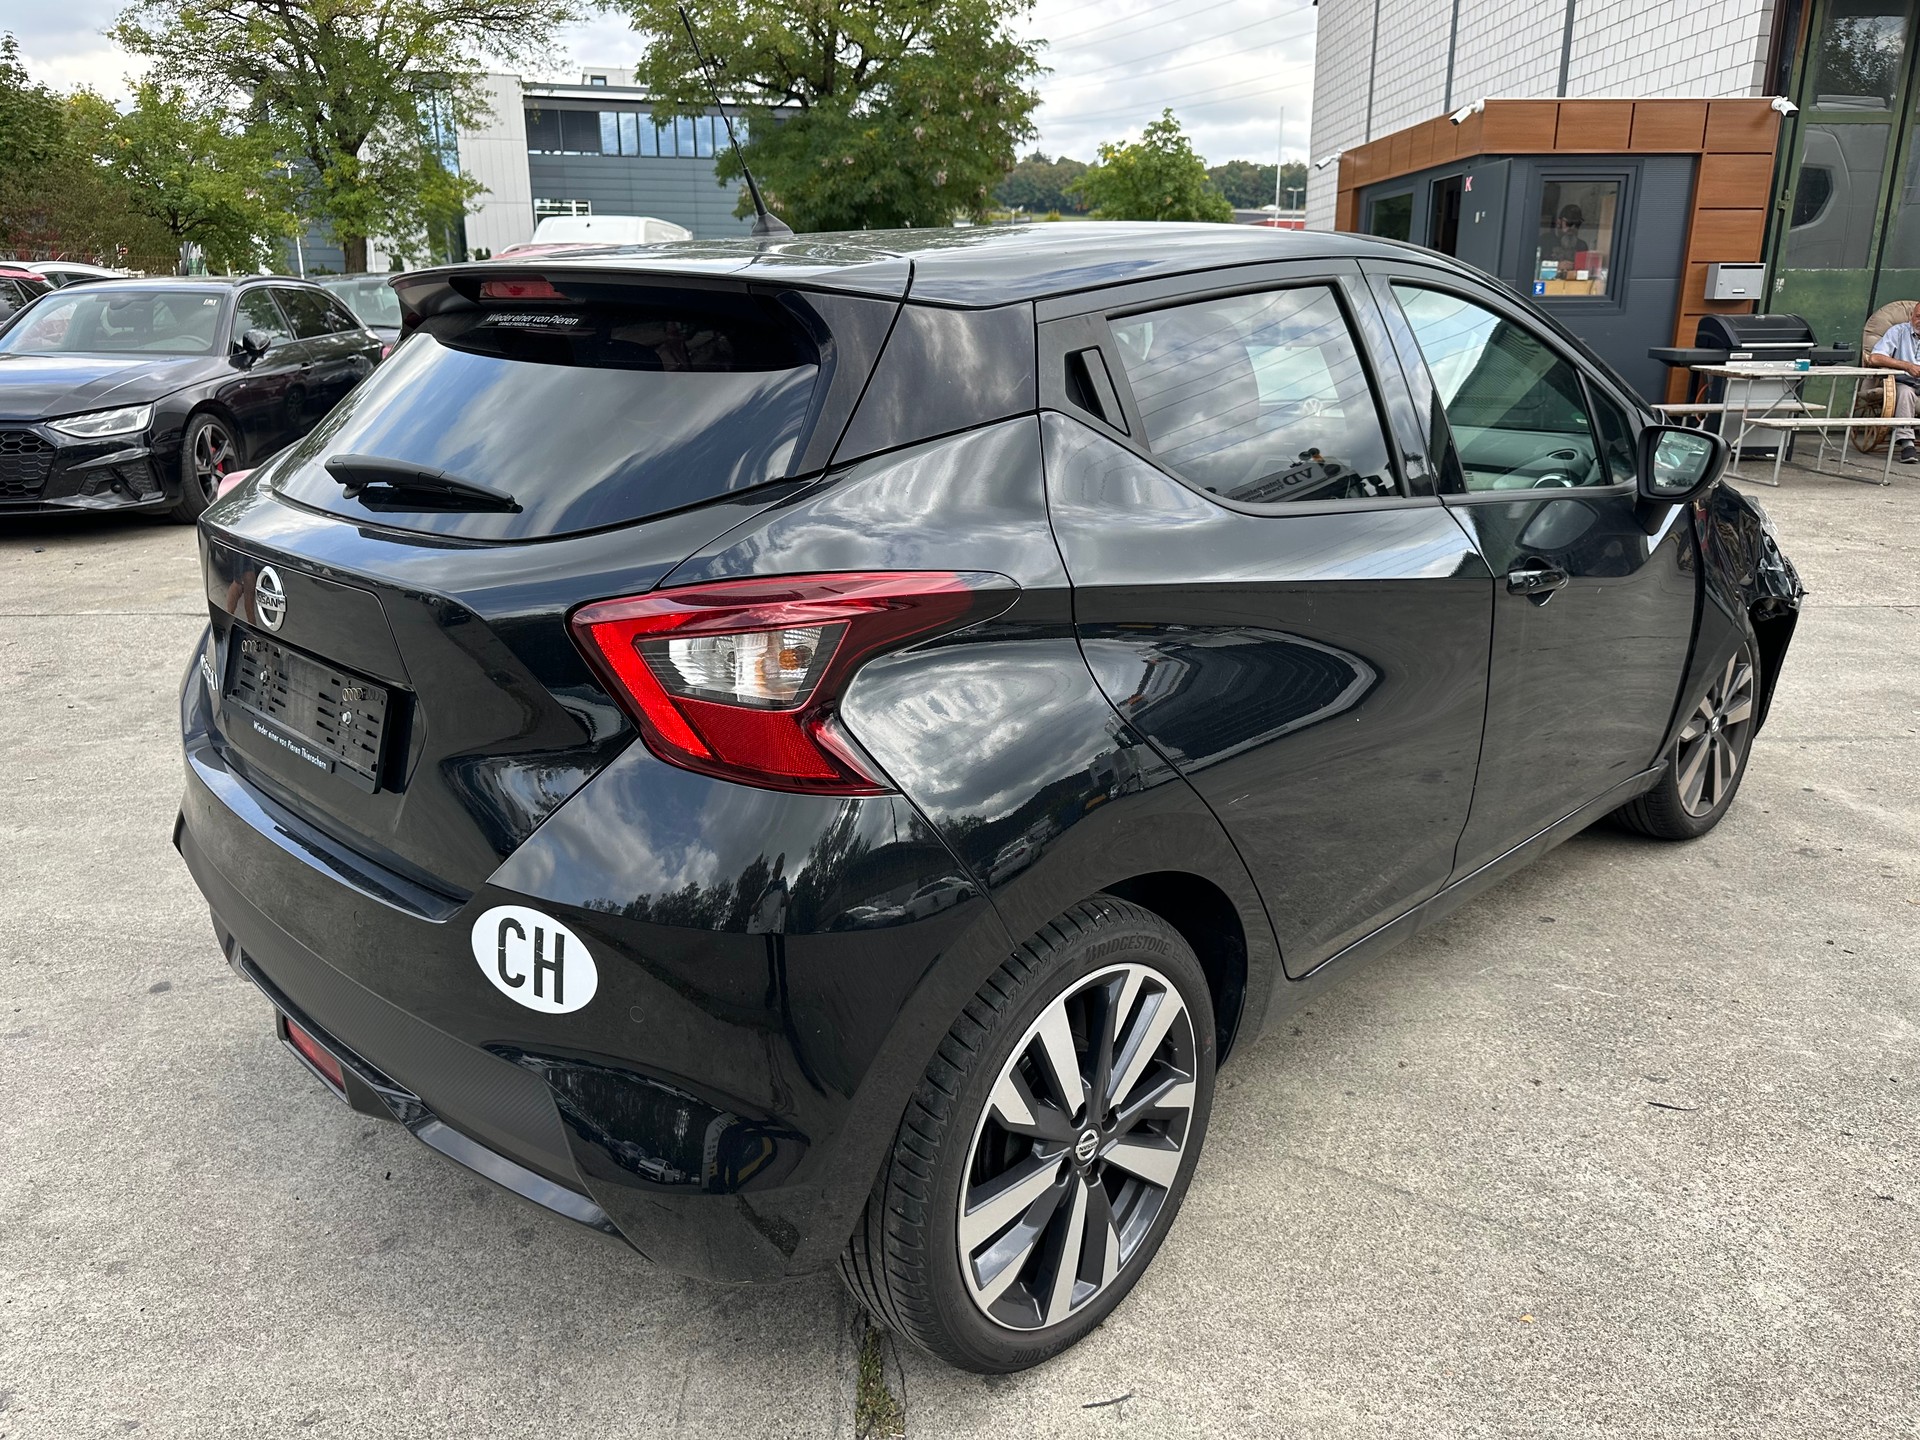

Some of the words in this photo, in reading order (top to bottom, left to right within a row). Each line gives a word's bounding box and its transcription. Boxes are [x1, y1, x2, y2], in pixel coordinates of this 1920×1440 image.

[1464, 176, 1473, 192] K
[486, 313, 514, 322] Wieder
[512, 313, 535, 322] einer
[533, 315, 550, 323] von
[548, 315, 579, 326] Pieren
[253, 720, 268, 736] Wieder
[268, 730, 279, 742] einer
[279, 737, 287, 747] von
[287, 740, 301, 755] Pieren
[498, 917, 565, 1005] CH
[1085, 935, 1171, 964] BRIDGESTONE
